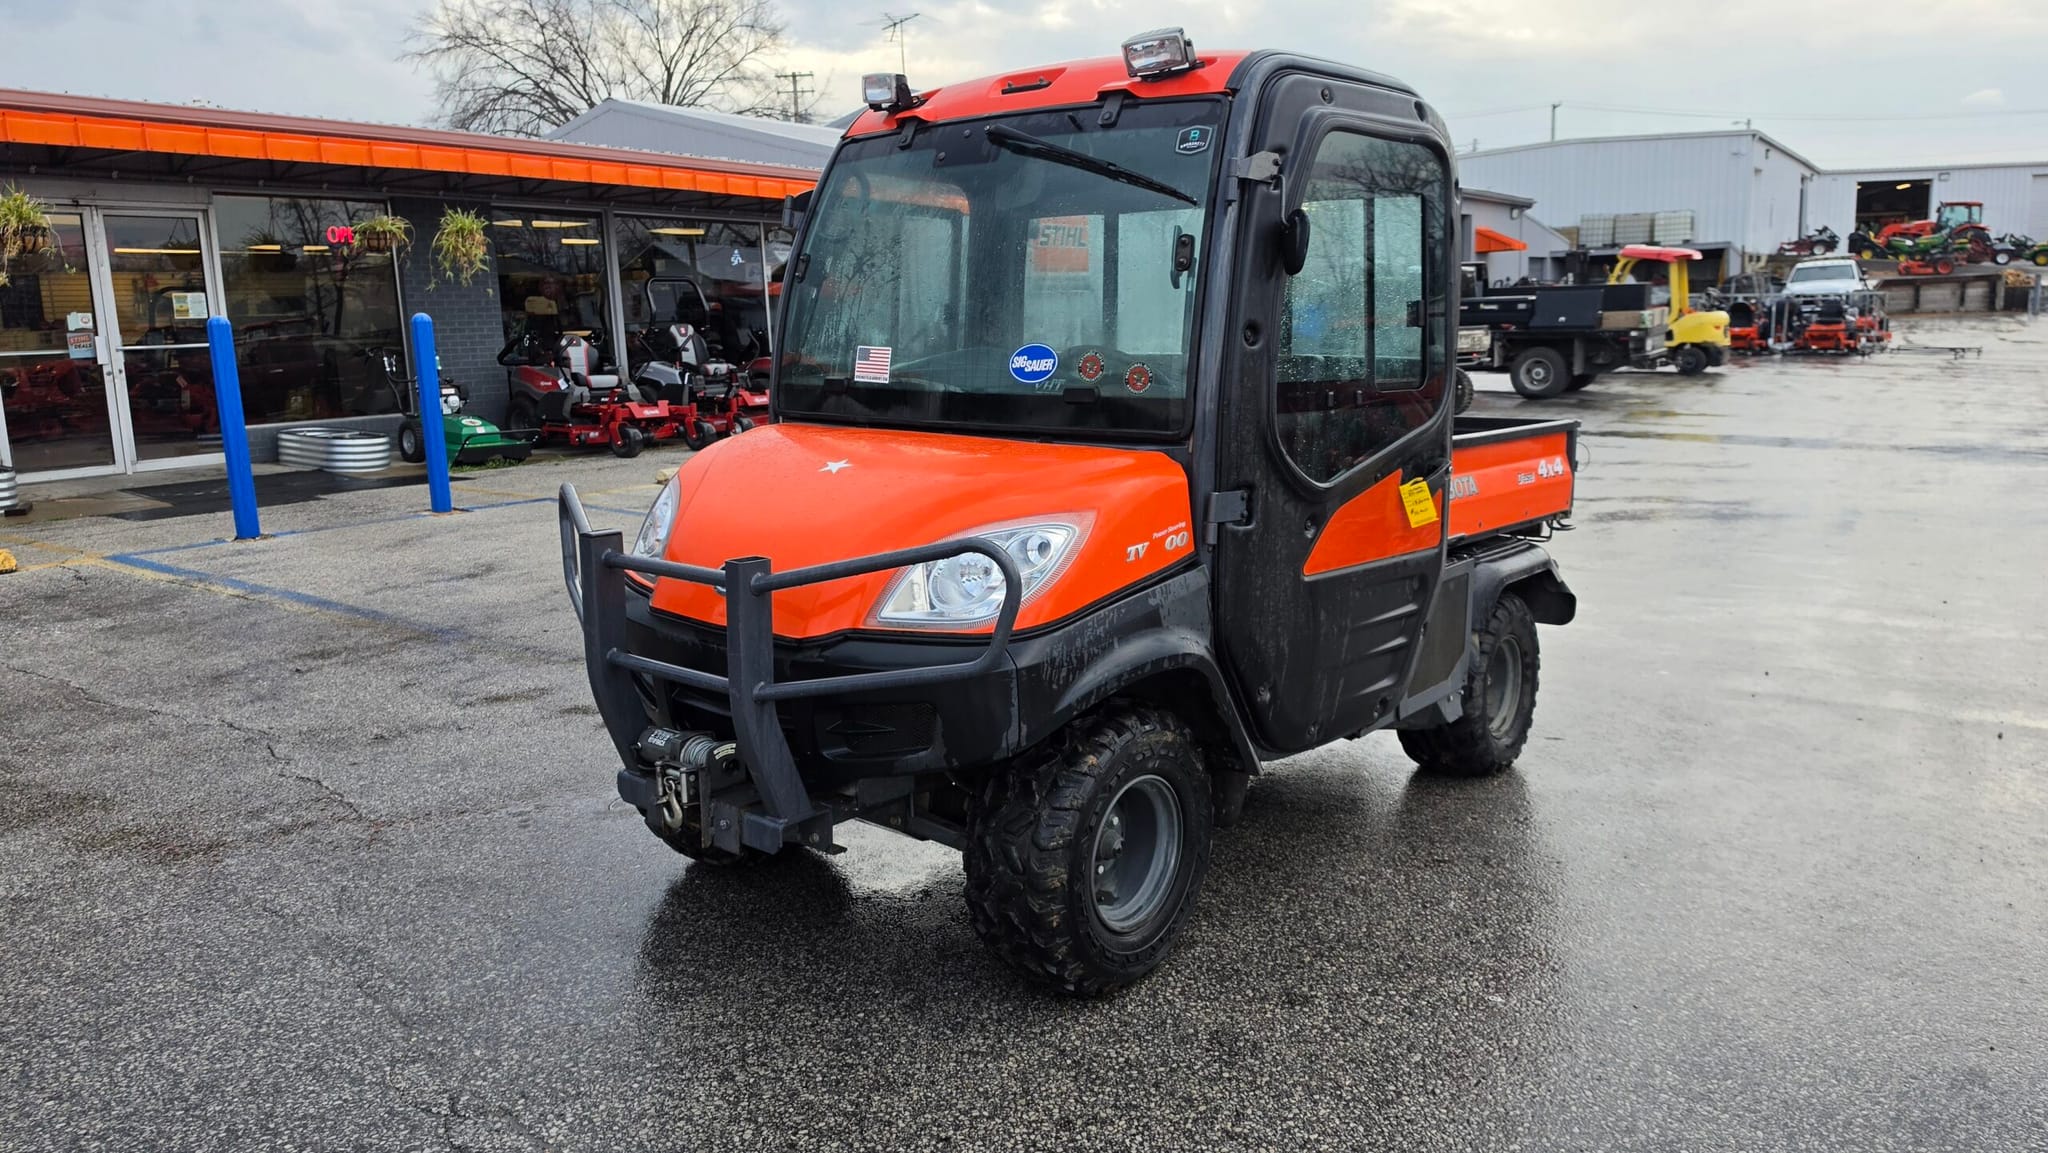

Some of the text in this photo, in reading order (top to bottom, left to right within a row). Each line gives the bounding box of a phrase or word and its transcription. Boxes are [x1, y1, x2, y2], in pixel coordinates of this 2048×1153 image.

[1040, 224, 1088, 248] STIHL
[1012, 355, 1054, 372] SIG SAUER
[1538, 457, 1563, 478] 4x4
[1449, 475, 1478, 500] BOTA
[1126, 541, 1150, 562] TV
